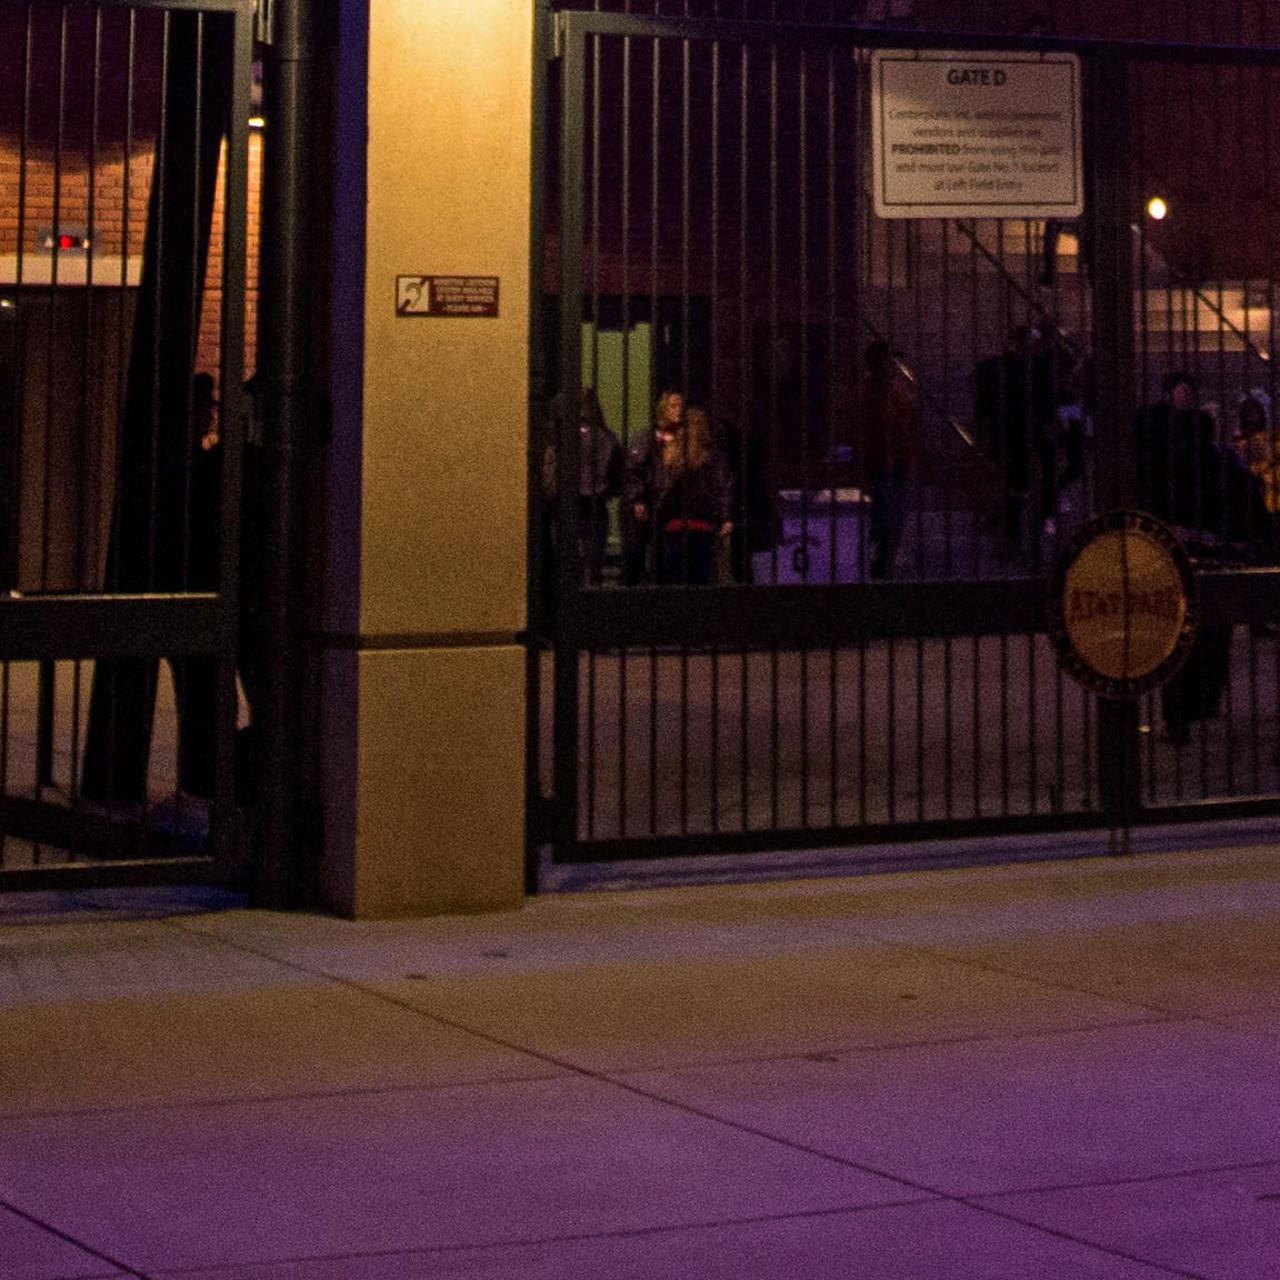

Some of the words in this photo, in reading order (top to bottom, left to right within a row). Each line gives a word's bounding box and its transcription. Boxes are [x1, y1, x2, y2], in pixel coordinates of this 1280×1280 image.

[947, 68, 990, 85] GATE
[993, 69, 1006, 85] D
[892, 143, 959, 154] PROHIBITED
